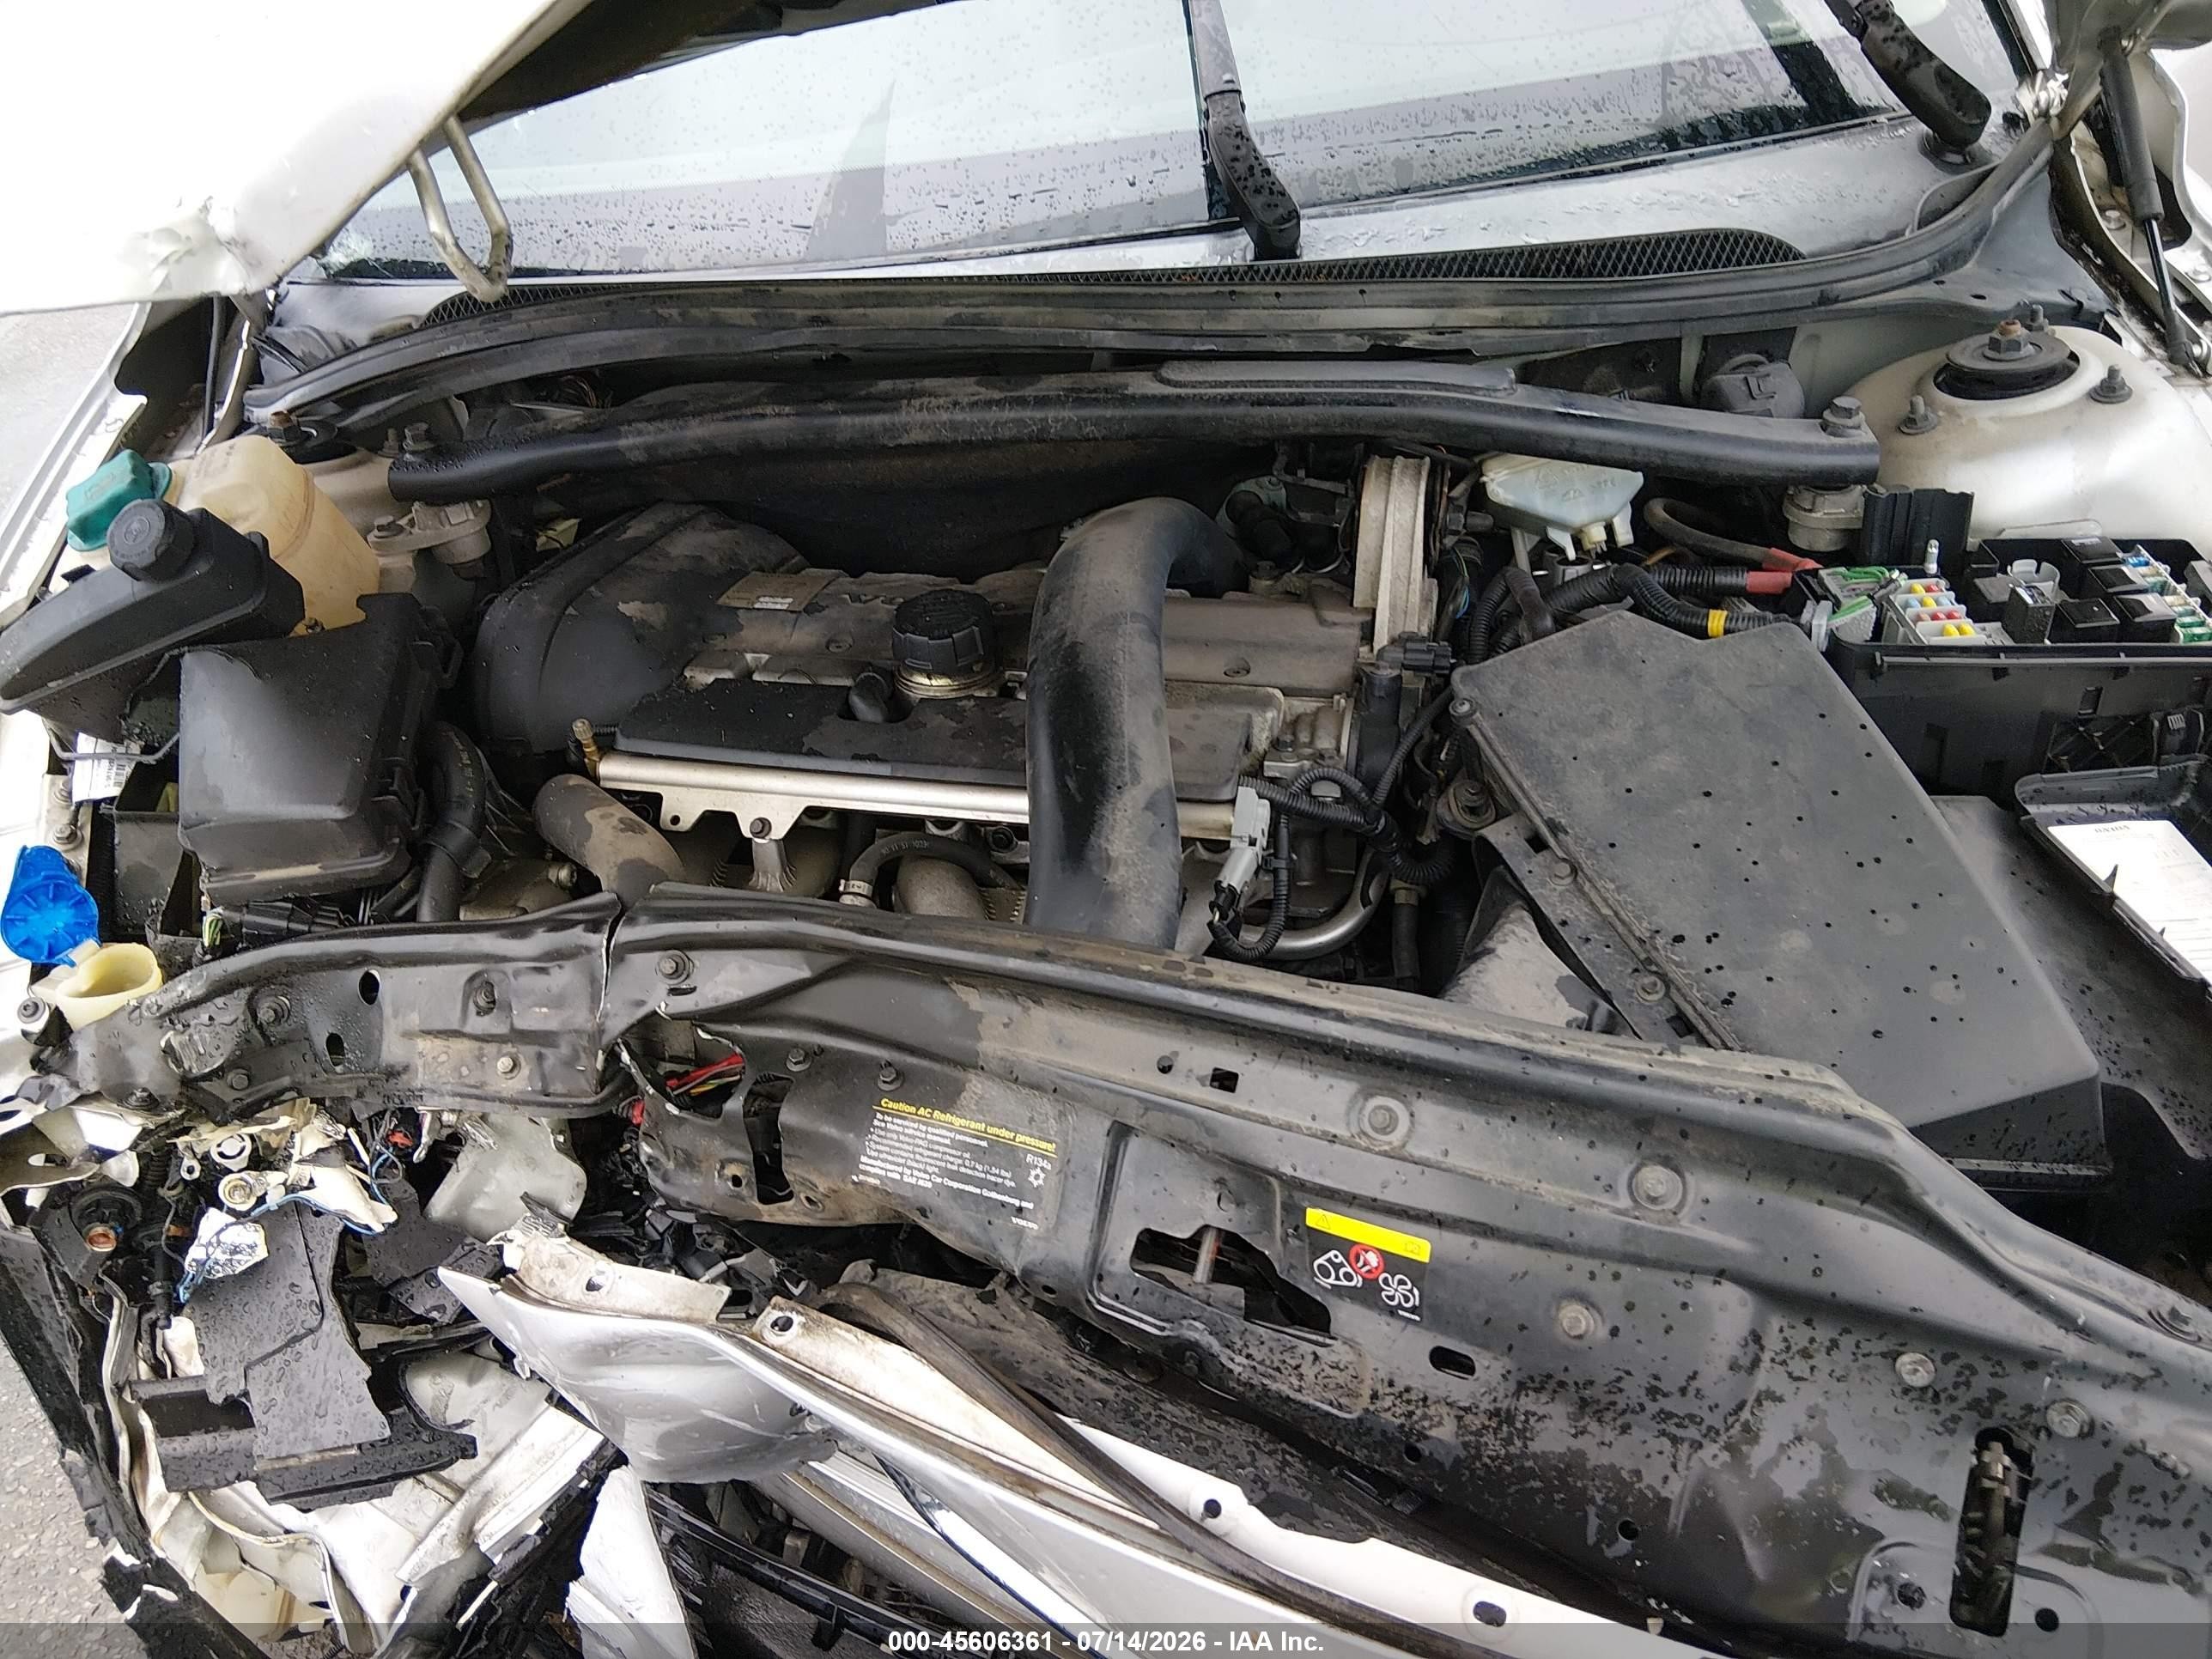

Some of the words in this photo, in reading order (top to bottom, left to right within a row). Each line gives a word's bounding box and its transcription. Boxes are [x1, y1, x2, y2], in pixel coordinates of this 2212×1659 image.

[881, 1098, 916, 1113] Caution
[917, 1107, 932, 1117] AC
[933, 1110, 985, 1131] Refrigerant
[987, 1126, 1015, 1139] under
[1015, 1133, 1055, 1152] pressure!
[1026, 1153, 1051, 1170] R134a
[943, 1177, 981, 1194] Corporation
